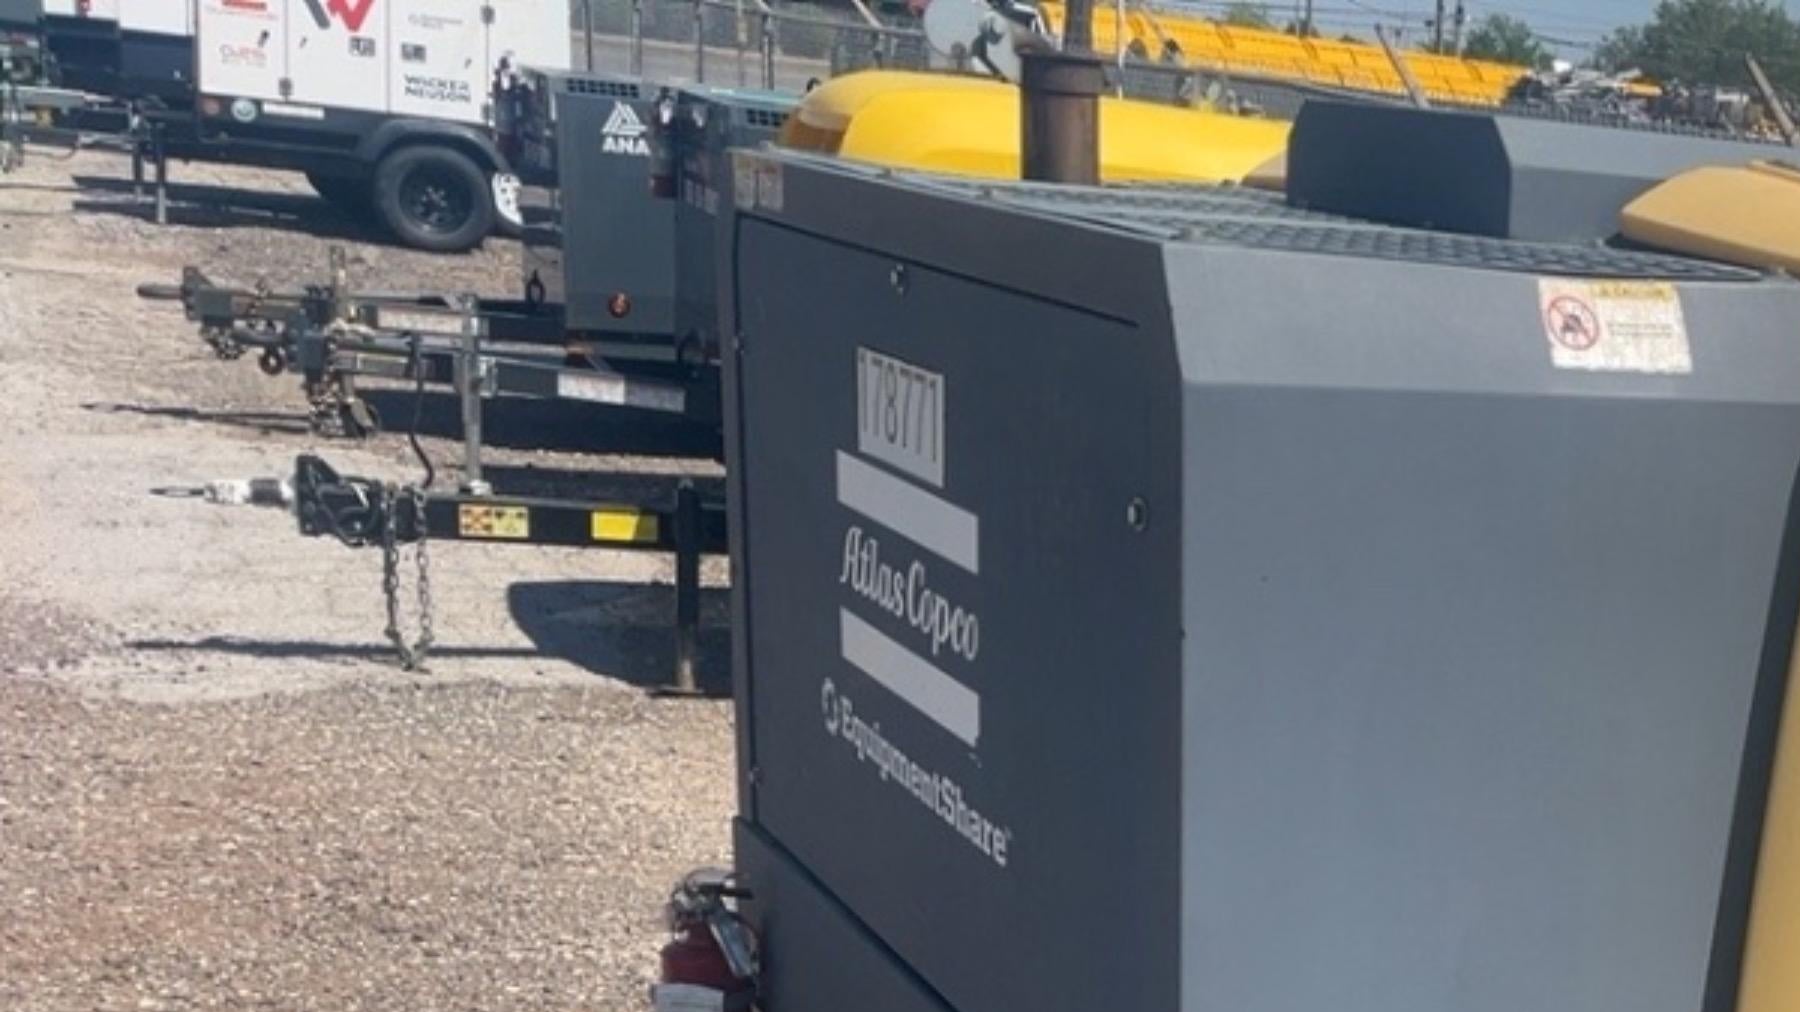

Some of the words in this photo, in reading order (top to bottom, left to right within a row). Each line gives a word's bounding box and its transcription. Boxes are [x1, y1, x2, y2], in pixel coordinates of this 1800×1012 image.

[602, 135, 651, 156] ANA
[858, 351, 937, 463] 178771
[840, 695, 1007, 867] EquipmentShare
